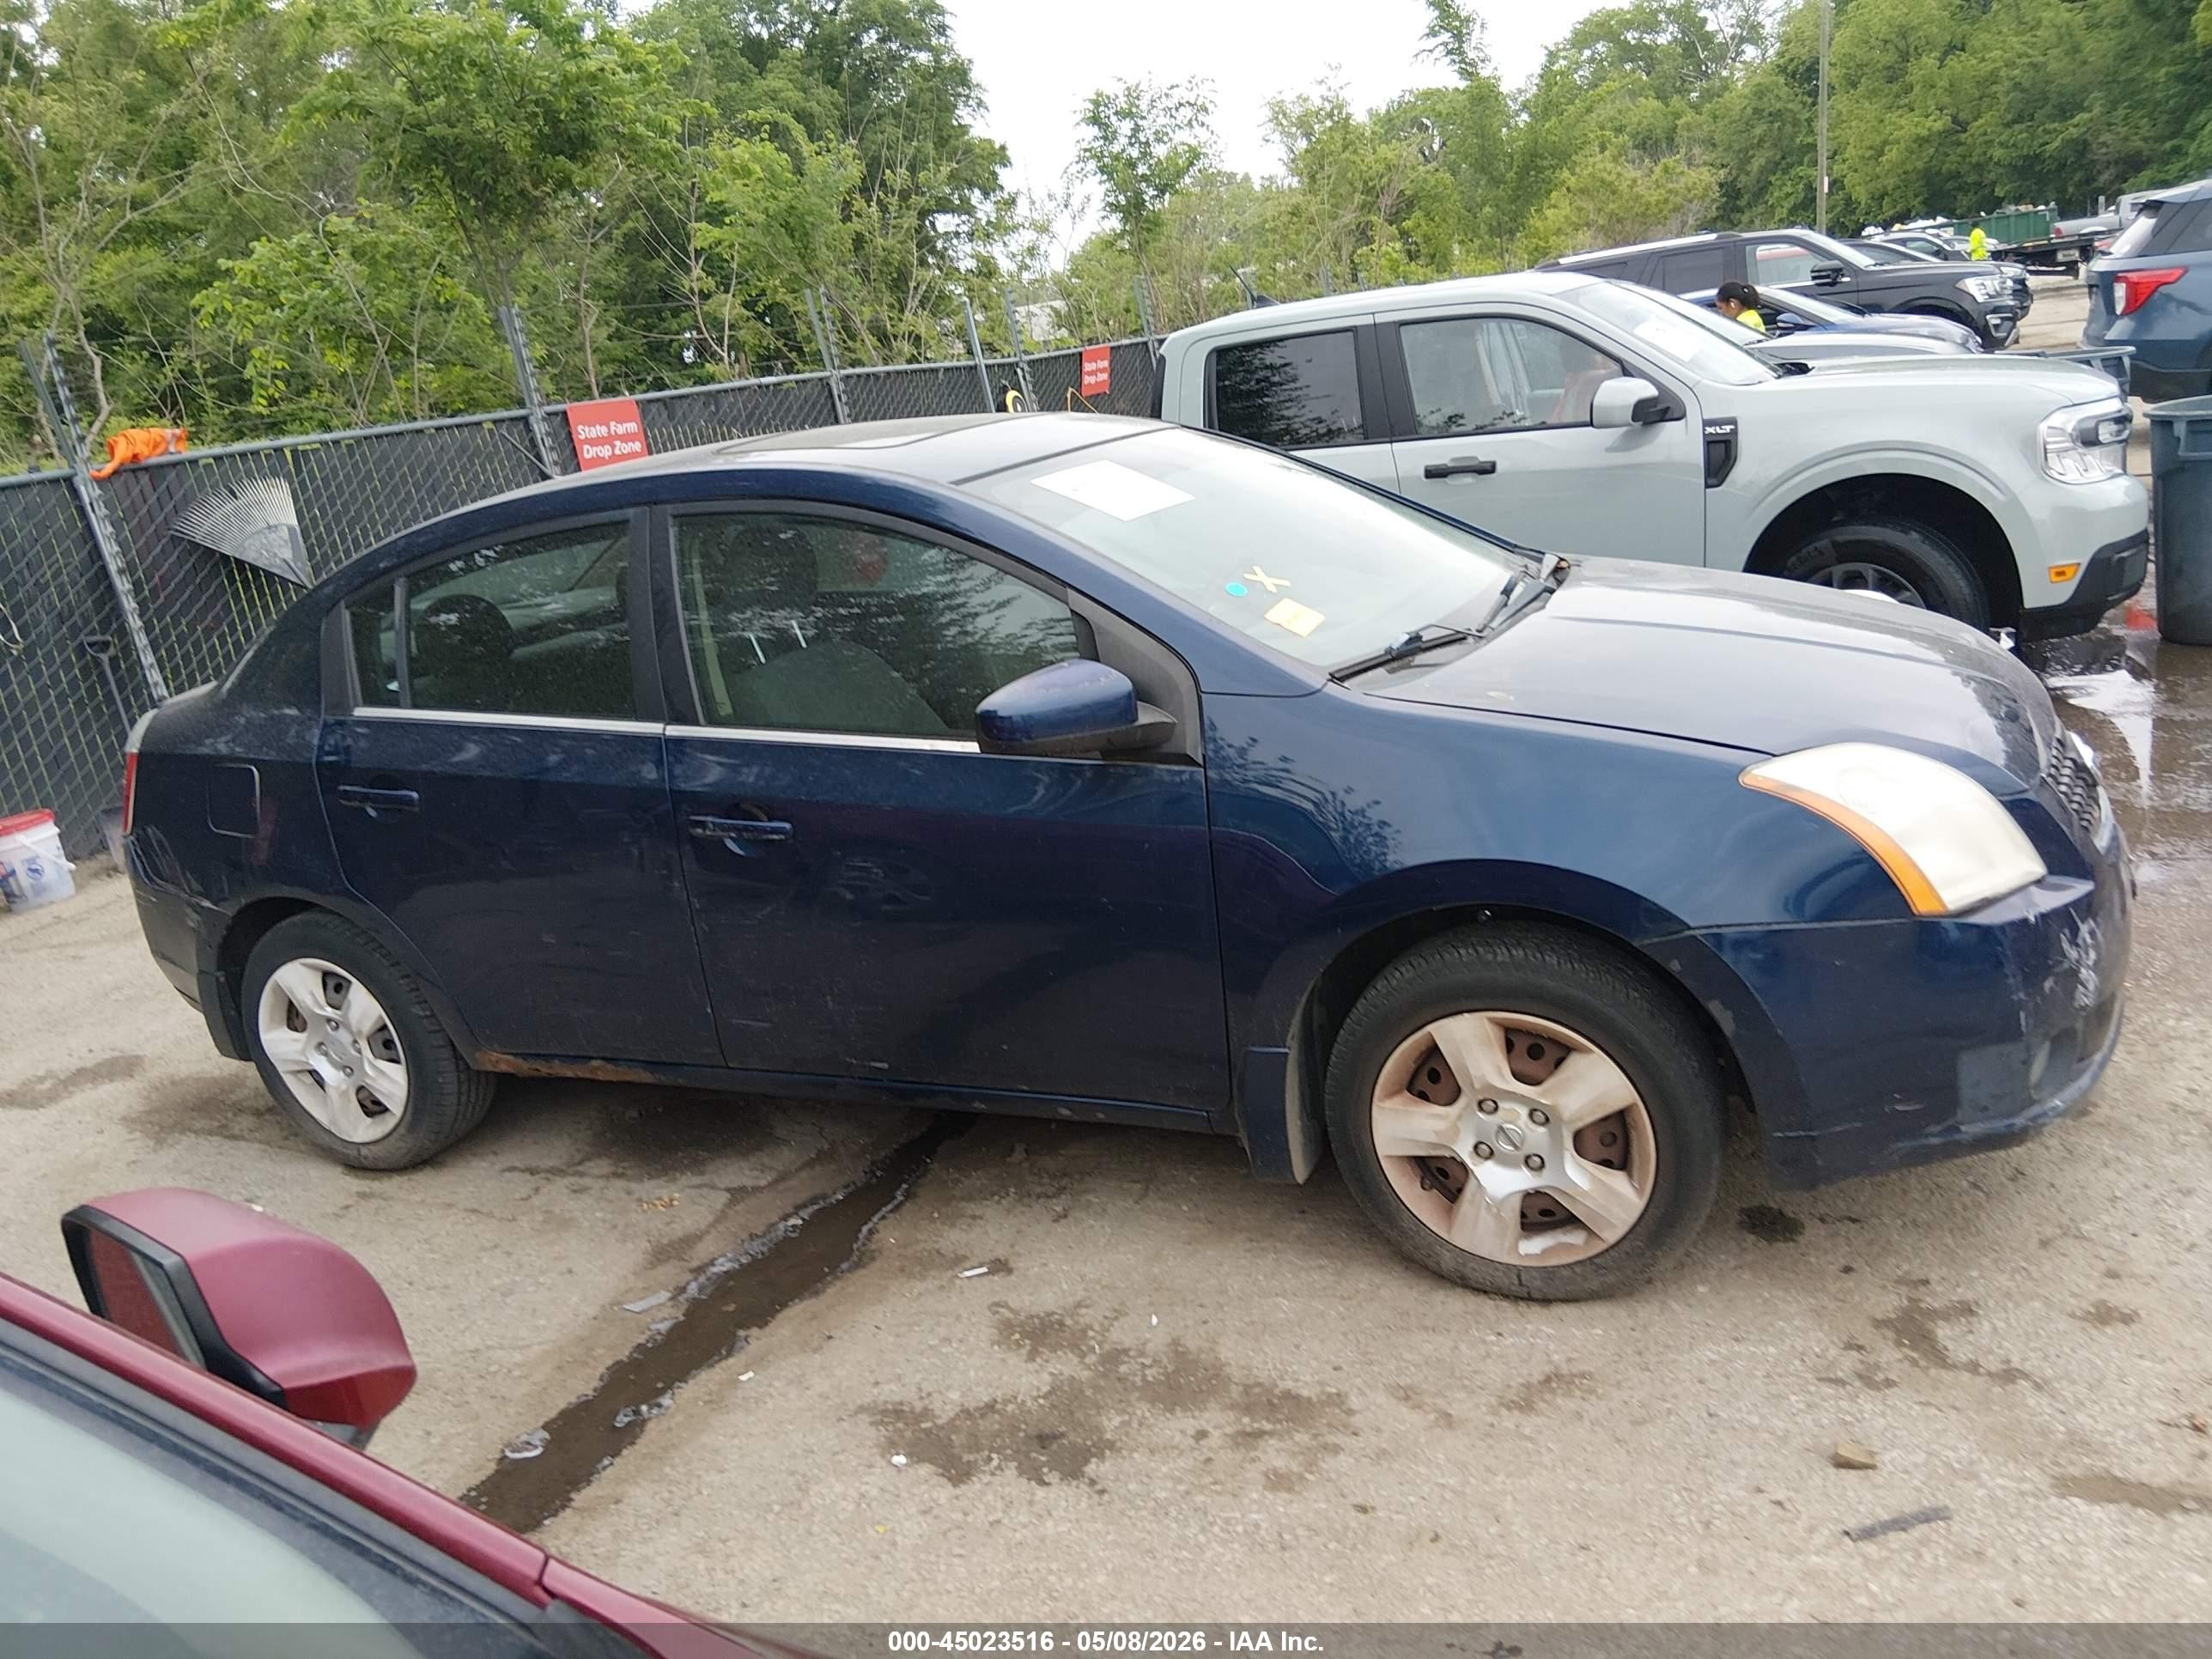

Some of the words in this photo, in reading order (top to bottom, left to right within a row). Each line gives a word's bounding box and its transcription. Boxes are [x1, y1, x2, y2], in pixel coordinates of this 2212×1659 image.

[577, 424, 609, 440] State
[609, 421, 638, 436] Farm
[1705, 424, 1735, 434] XLT
[583, 443, 612, 459] Drop
[613, 440, 642, 455] Zone
